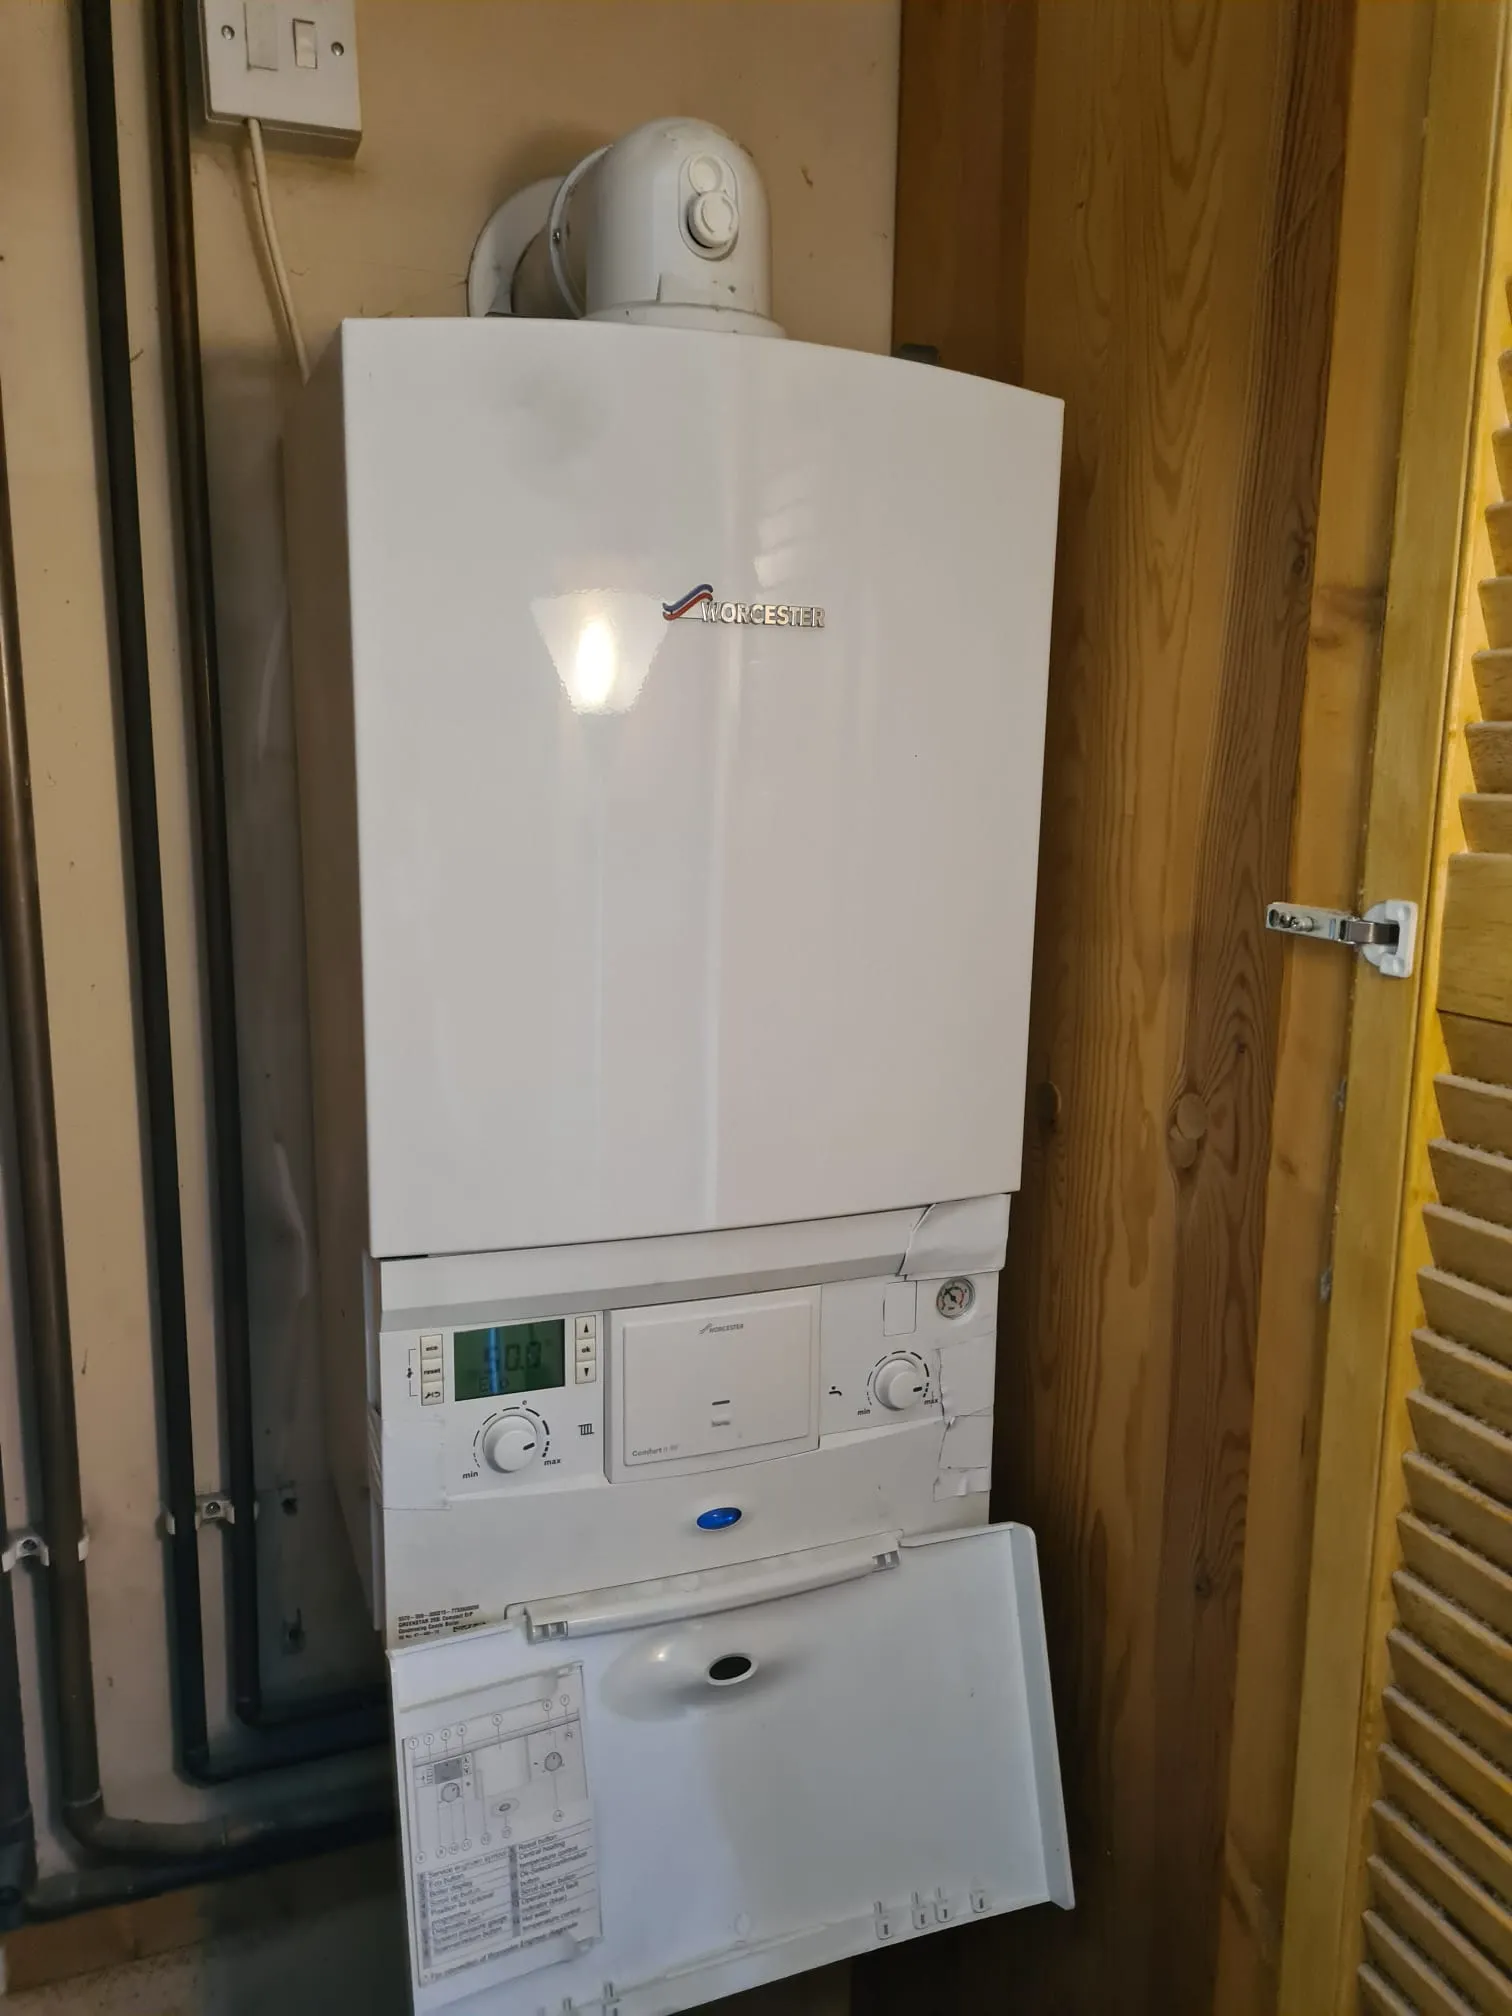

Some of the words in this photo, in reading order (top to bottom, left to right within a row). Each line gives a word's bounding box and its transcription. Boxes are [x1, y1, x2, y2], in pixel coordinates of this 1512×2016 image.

[701, 601, 826, 628] WORCESTER
[709, 1323, 744, 1333] WORCESTER
[423, 1367, 441, 1376] reset
[544, 1458, 562, 1466] max
[462, 1470, 479, 1480] min
